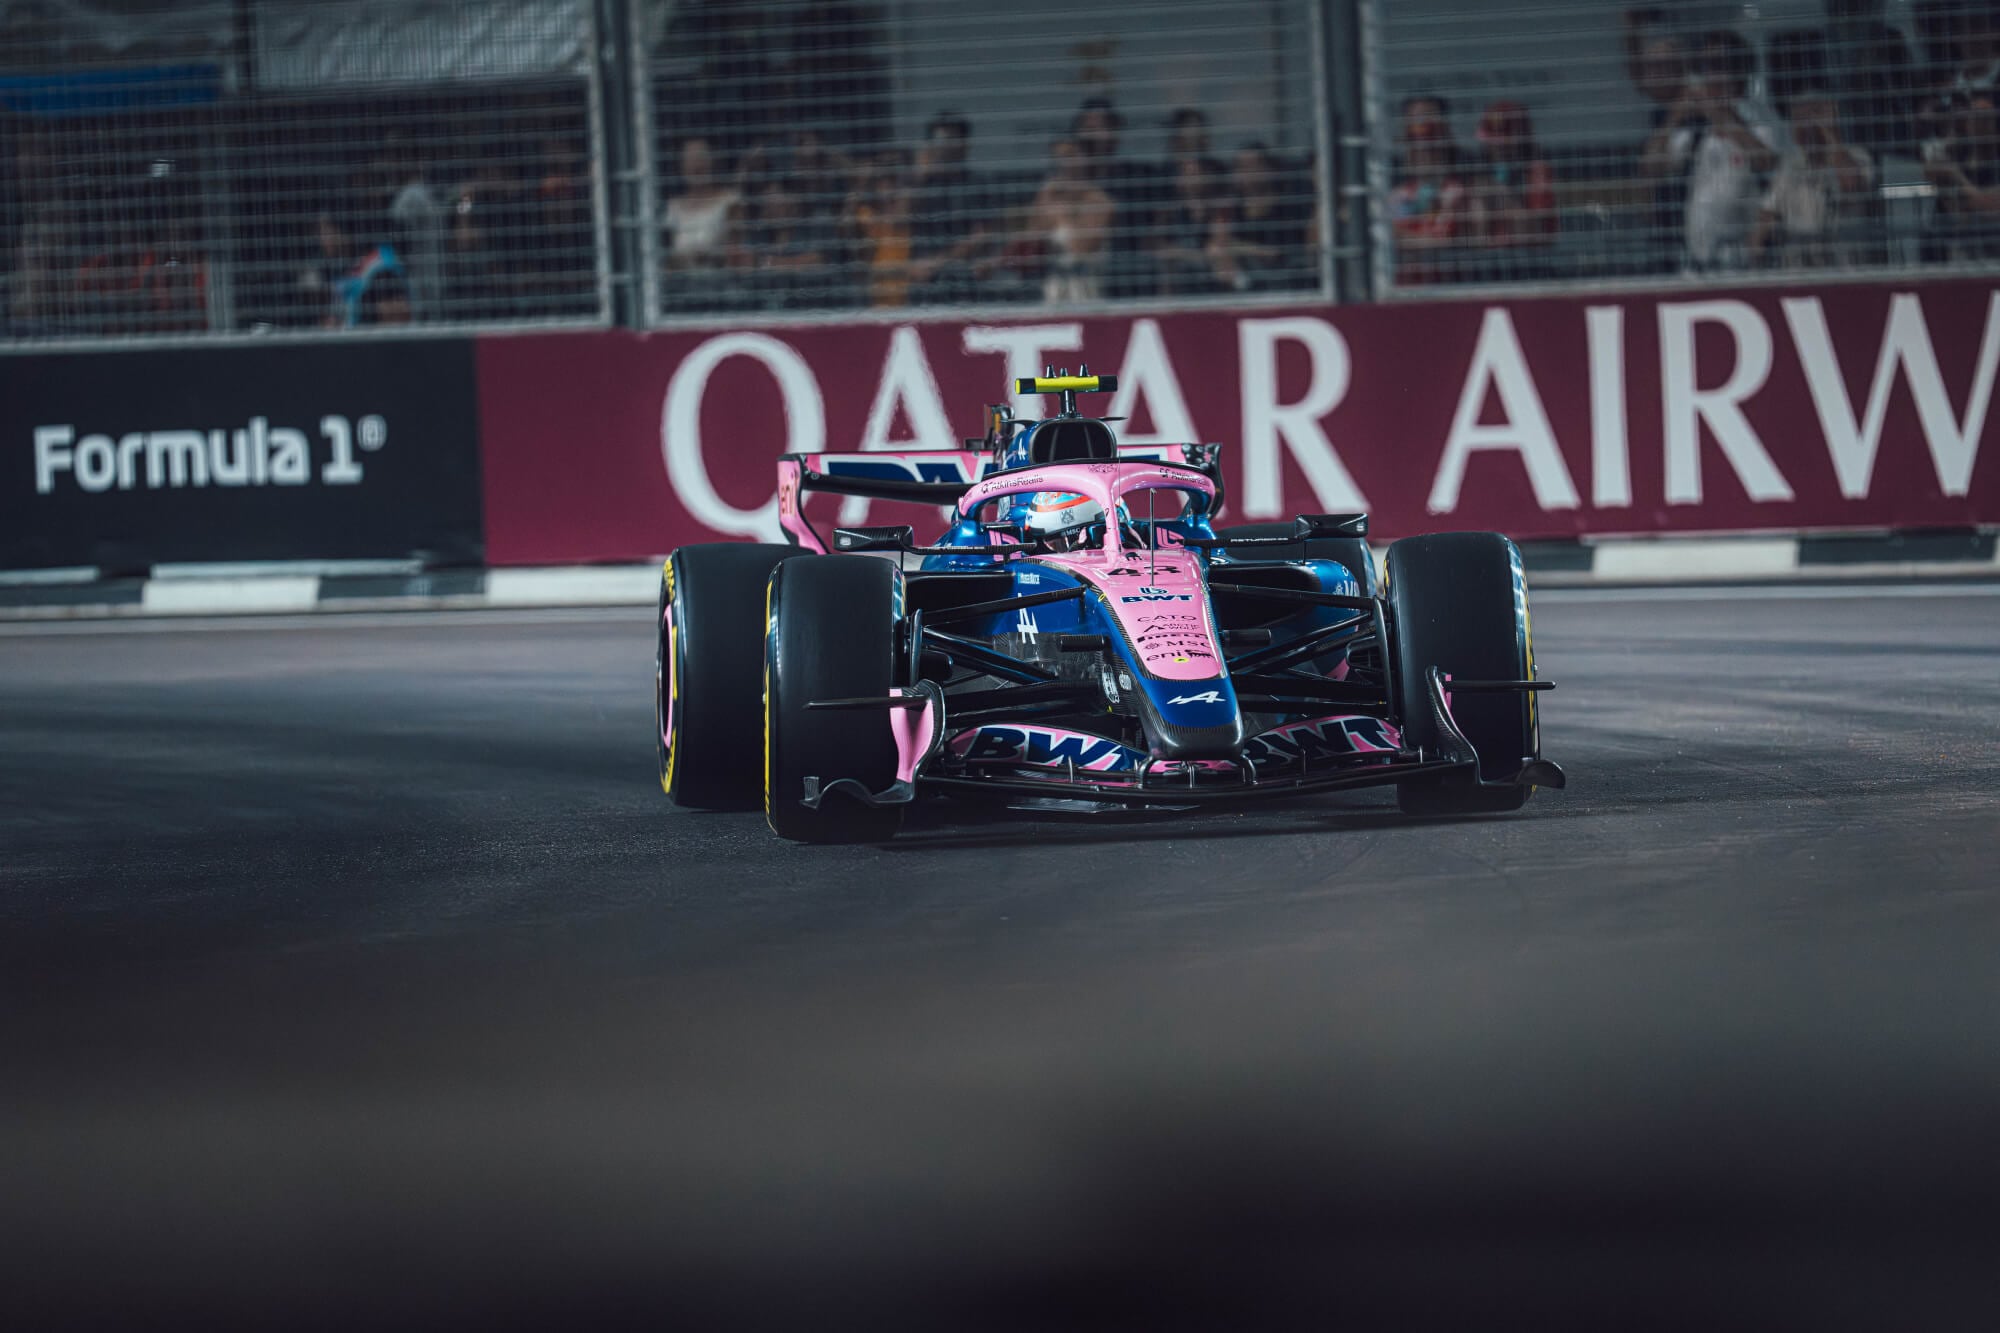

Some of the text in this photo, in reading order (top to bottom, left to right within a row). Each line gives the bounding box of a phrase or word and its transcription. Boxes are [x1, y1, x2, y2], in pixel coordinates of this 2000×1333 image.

[661, 290, 2000, 537] QATAR AIRW
[34, 415, 311, 494] Formula
[1108, 565, 1182, 577] 43
[1120, 594, 1194, 604] BWT
[1137, 614, 1198, 623] CATO
[1146, 650, 1183, 661] eni
